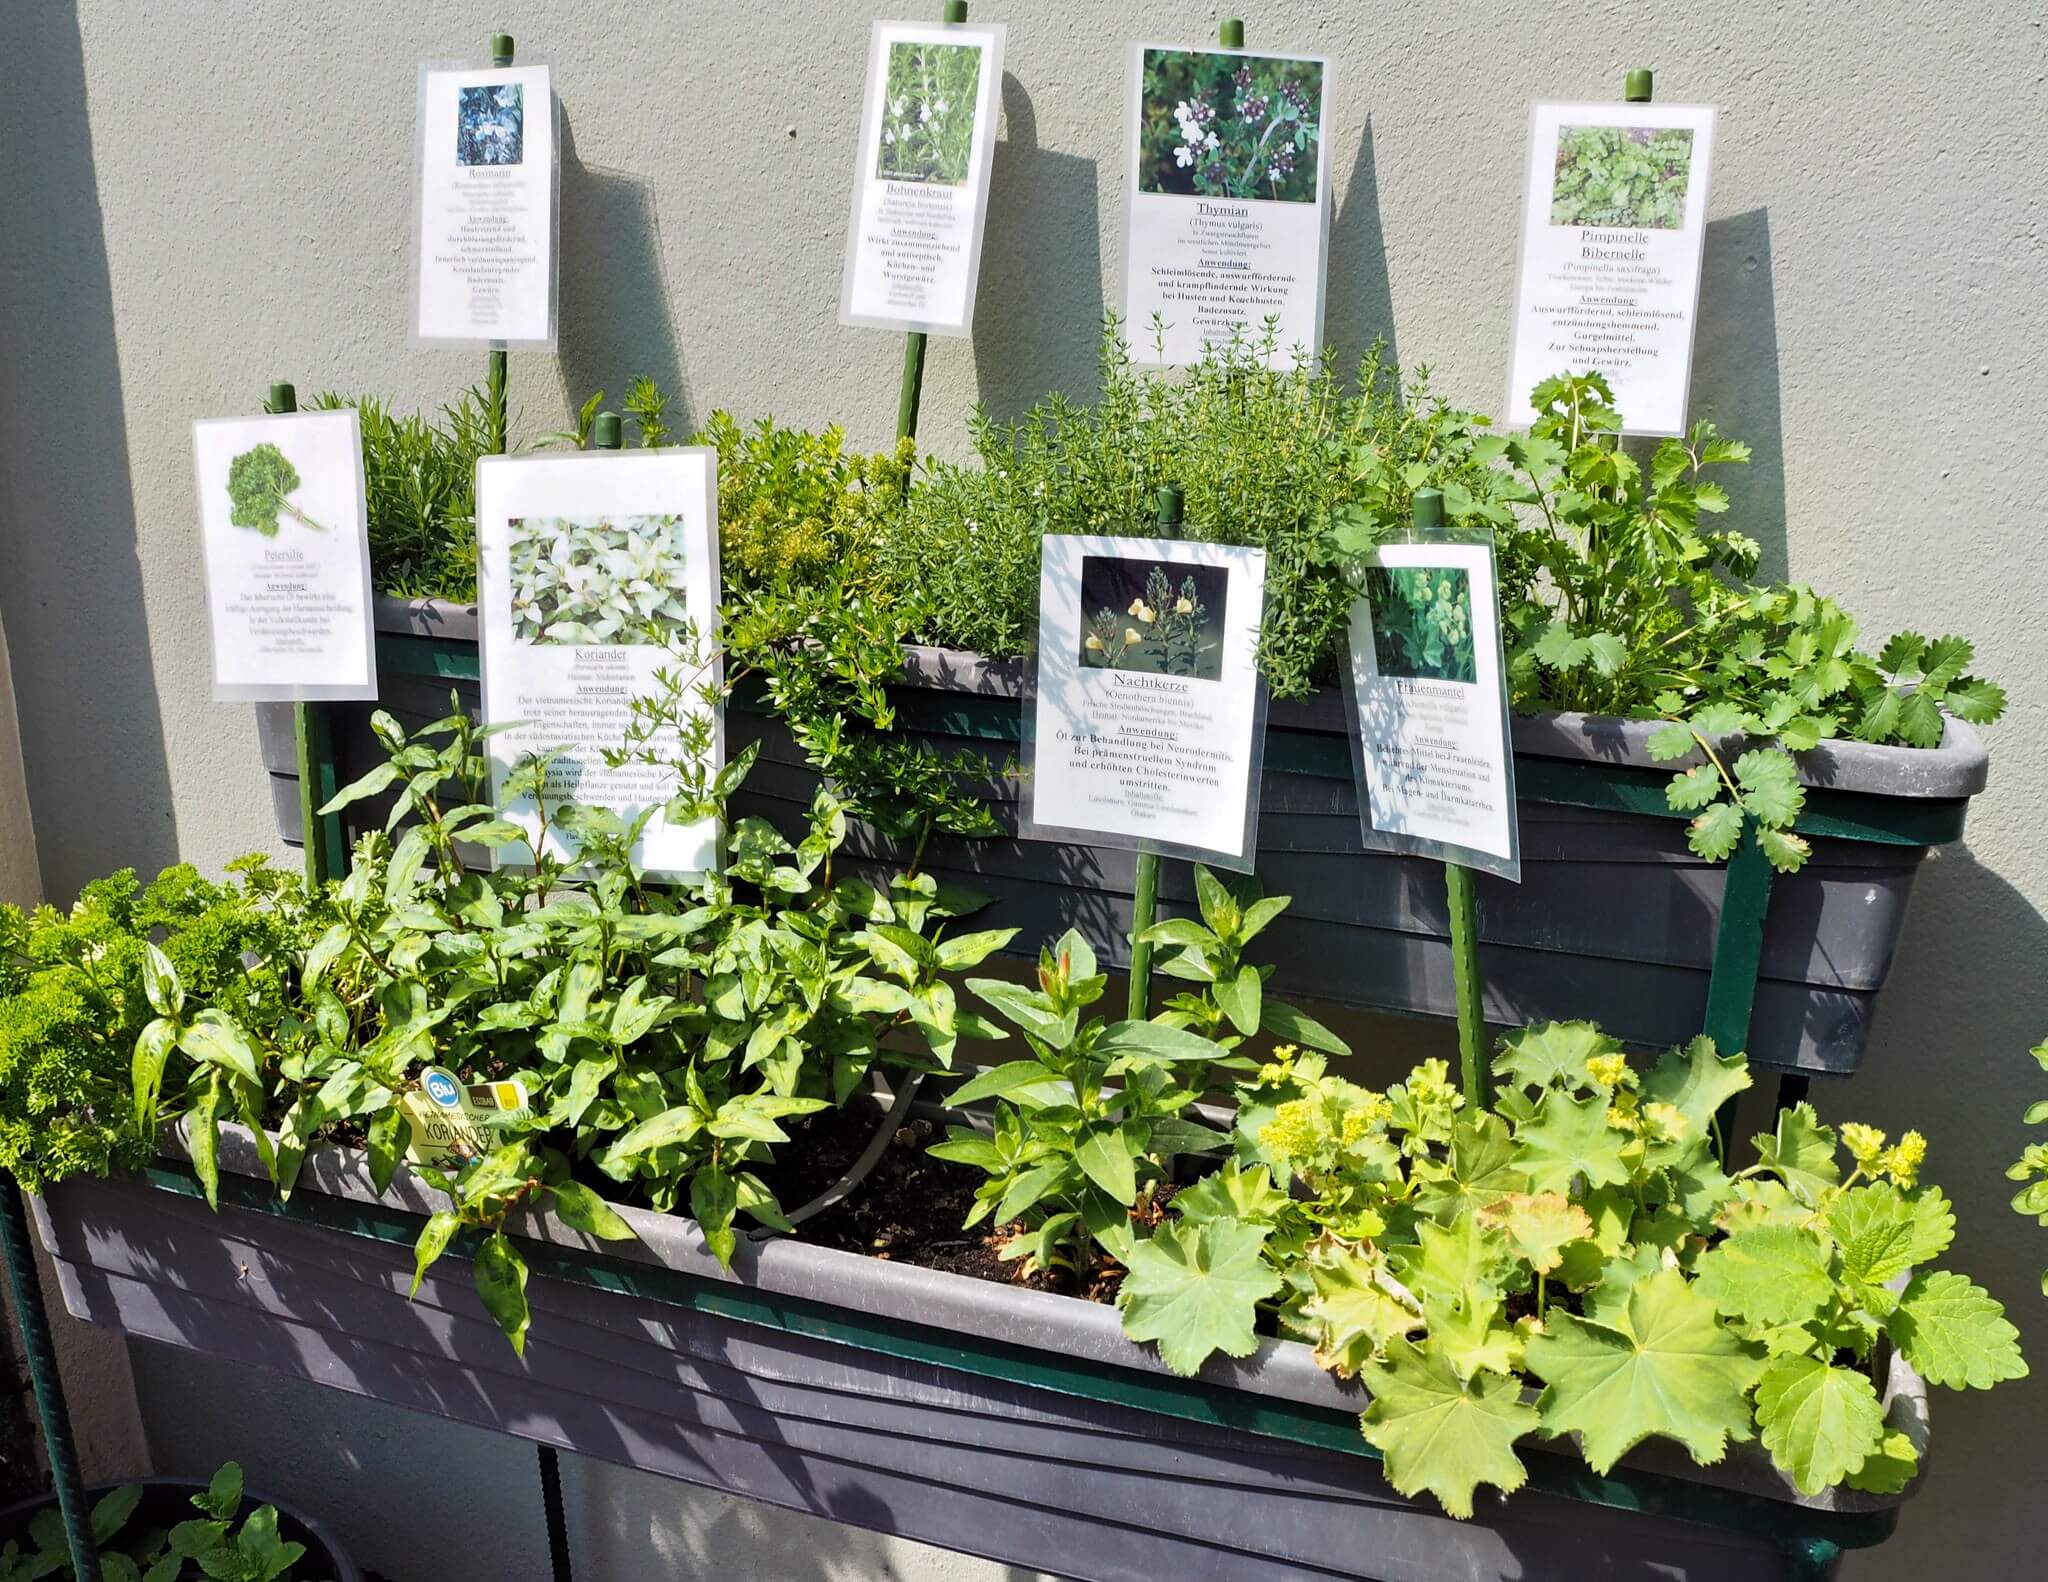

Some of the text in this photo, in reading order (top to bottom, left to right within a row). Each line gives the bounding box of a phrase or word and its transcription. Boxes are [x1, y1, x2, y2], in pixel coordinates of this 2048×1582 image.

[469, 168, 511, 177] Rosmarin
[887, 183, 952, 199] Bohnenkraut
[1197, 203, 1248, 217] Thymian
[1190, 218, 1263, 231] (Thymus vulgaris)
[868, 235, 889, 245] Wirkt
[1581, 230, 1649, 245] Pimpinelle
[880, 249, 895, 257] und
[1582, 247, 1646, 261] Bibernelle
[920, 263, 936, 272] und
[1198, 258, 1251, 270] Anwendung:
[1563, 263, 1661, 275] (Pimpinella saxifraga)
[1151, 267, 1296, 283] Schleimlösende, auswurffördernde
[1177, 281, 1249, 292] krampflindernde
[1251, 284, 1289, 295] Wirkung
[1162, 292, 1175, 300] bei
[1177, 293, 1207, 302] Husten
[1209, 295, 1226, 303] und
[1579, 295, 1638, 306] Anwendung:
[1198, 305, 1247, 315] Badezusatz.
[1531, 305, 1685, 320] Auswurffördernd, schleimlösend,
[1548, 343, 1659, 357] Zur Schnapsherstellung
[264, 549, 304, 561] Petersilie
[575, 648, 627, 660] Koriander
[577, 684, 627, 694] Anwendung:
[1114, 674, 1189, 692] Nachtkerze
[1397, 680, 1464, 697] Frauenmantel
[1105, 690, 1156, 704] (Oenothera
[1119, 725, 1178, 741] Anwendung:
[1056, 731, 1068, 741] Öl
[1070, 733, 1087, 743] zur
[1090, 734, 1148, 750] Behandlung
[1150, 739, 1165, 750] bei
[1376, 743, 1410, 755] Beliebtes
[1410, 747, 1434, 758] Mittel
[1435, 750, 1446, 760] bei
[1074, 746, 1217, 773] Bei prämenstruellem Syndrom
[584, 770, 597, 778] der
[1069, 760, 1219, 786] und erhöhten Cholesterinwerten
[1382, 759, 1490, 783] während der Menstruation und
[1405, 774, 1418, 782] des
[551, 780, 561, 788] als
[1119, 779, 1171, 792] umstritten.
[621, 792, 633, 801] und
[1382, 783, 1395, 793] Bei
[1397, 785, 1424, 797] Magen-
[1426, 791, 1439, 800] und
[424, 1123, 494, 1143] KORIANDER
